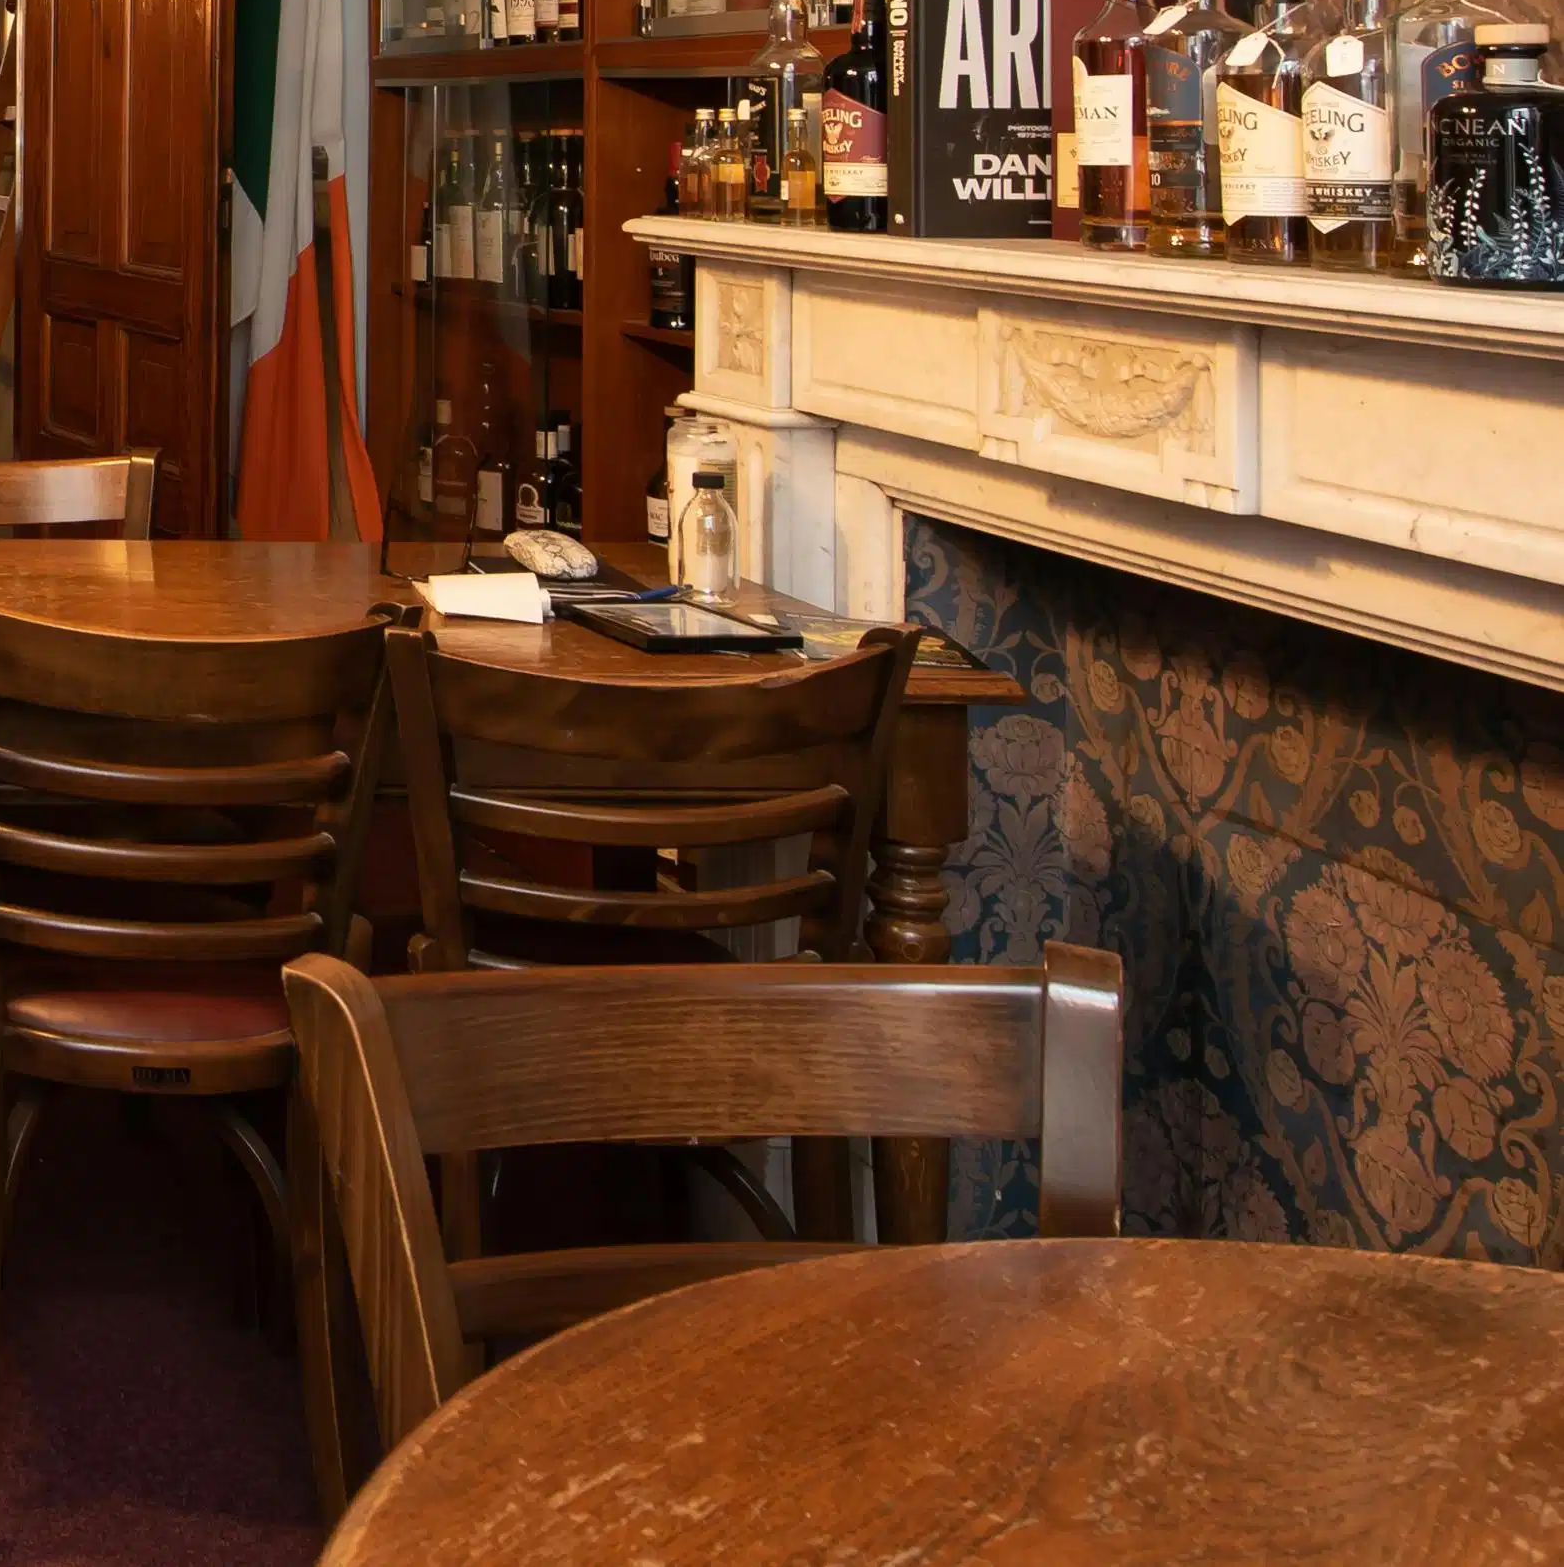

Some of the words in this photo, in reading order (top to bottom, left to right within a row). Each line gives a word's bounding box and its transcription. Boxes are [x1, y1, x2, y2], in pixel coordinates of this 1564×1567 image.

[1443, 138, 1499, 147] ORGANIC
[1151, 174, 1161, 185] 10
[1316, 187, 1372, 197] WHISKEY
